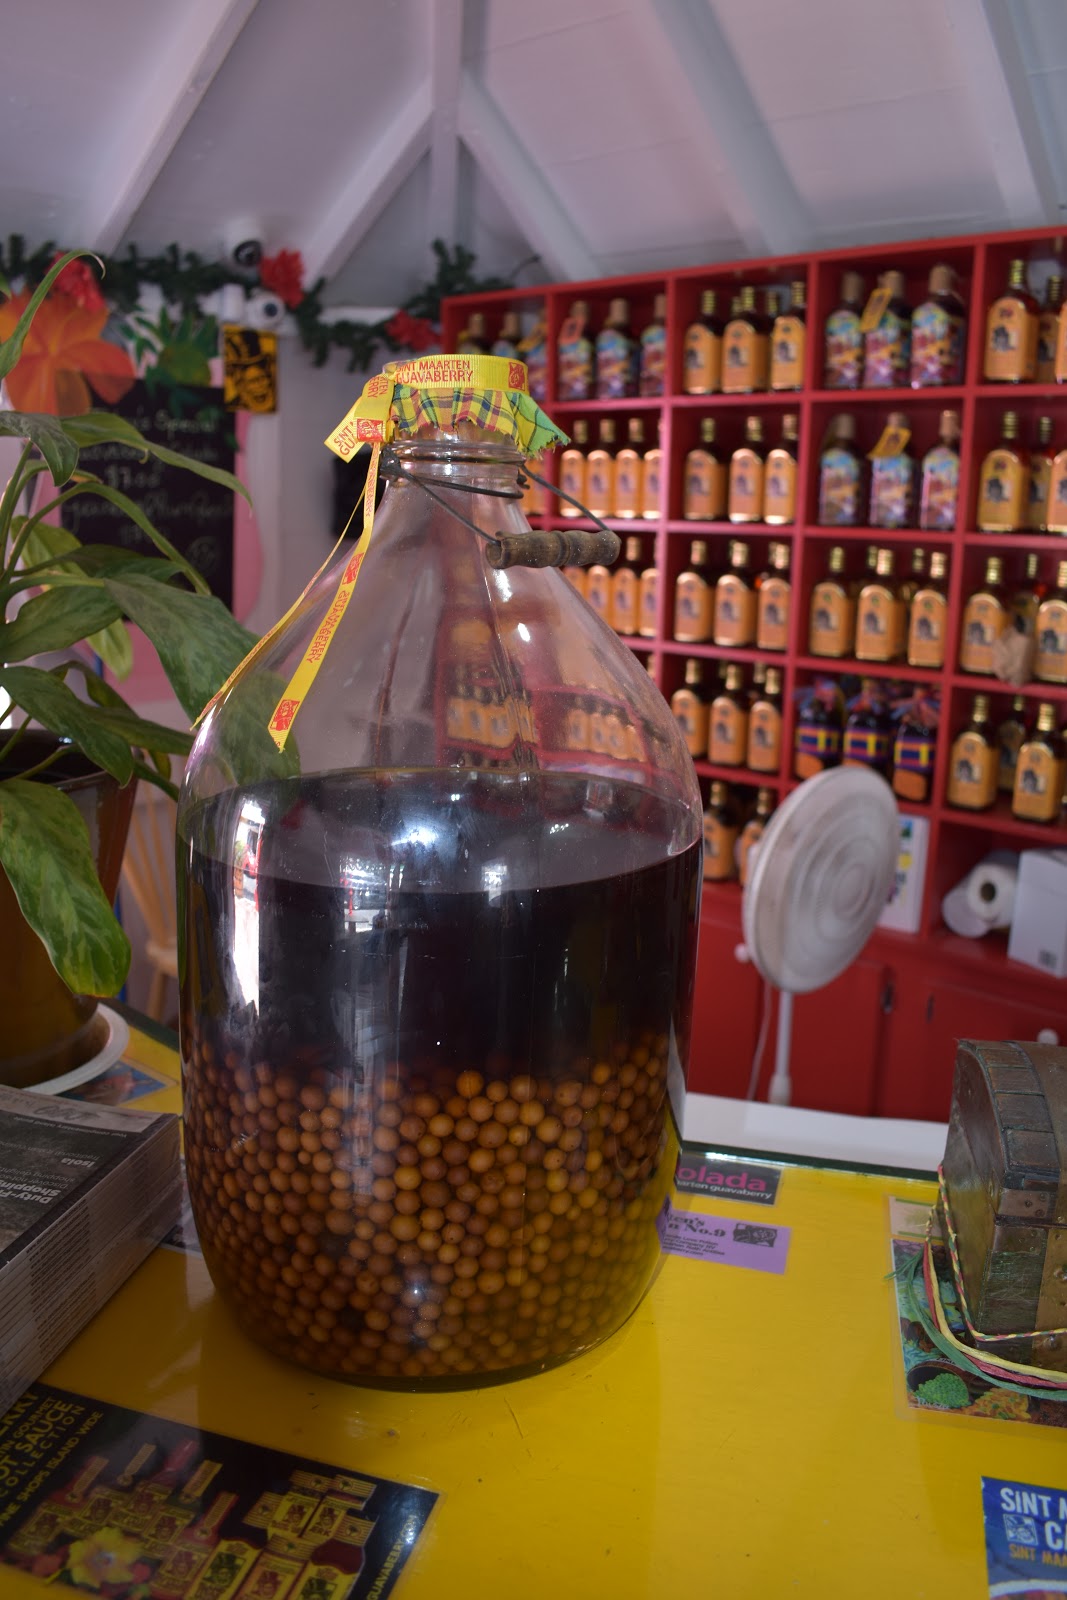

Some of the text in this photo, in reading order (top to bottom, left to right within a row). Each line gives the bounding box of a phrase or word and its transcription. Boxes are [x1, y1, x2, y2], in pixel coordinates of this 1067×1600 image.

[419, 360, 470, 371] MAARTEN
[395, 370, 473, 384] GUAVABERRY
[60, 1158, 96, 1168] Isola
[710, 1184, 773, 1199] guavaberry
[685, 1223, 726, 1237] No.9
[13, 1397, 56, 1438] GOURMET
[15, 1401, 73, 1453] SAUCE
[46, 1436, 80, 1469] ISLAND
[76, 1411, 104, 1436] WIDE
[1000, 1487, 1051, 1518] SINT
[1009, 1543, 1036, 1561] SINT
